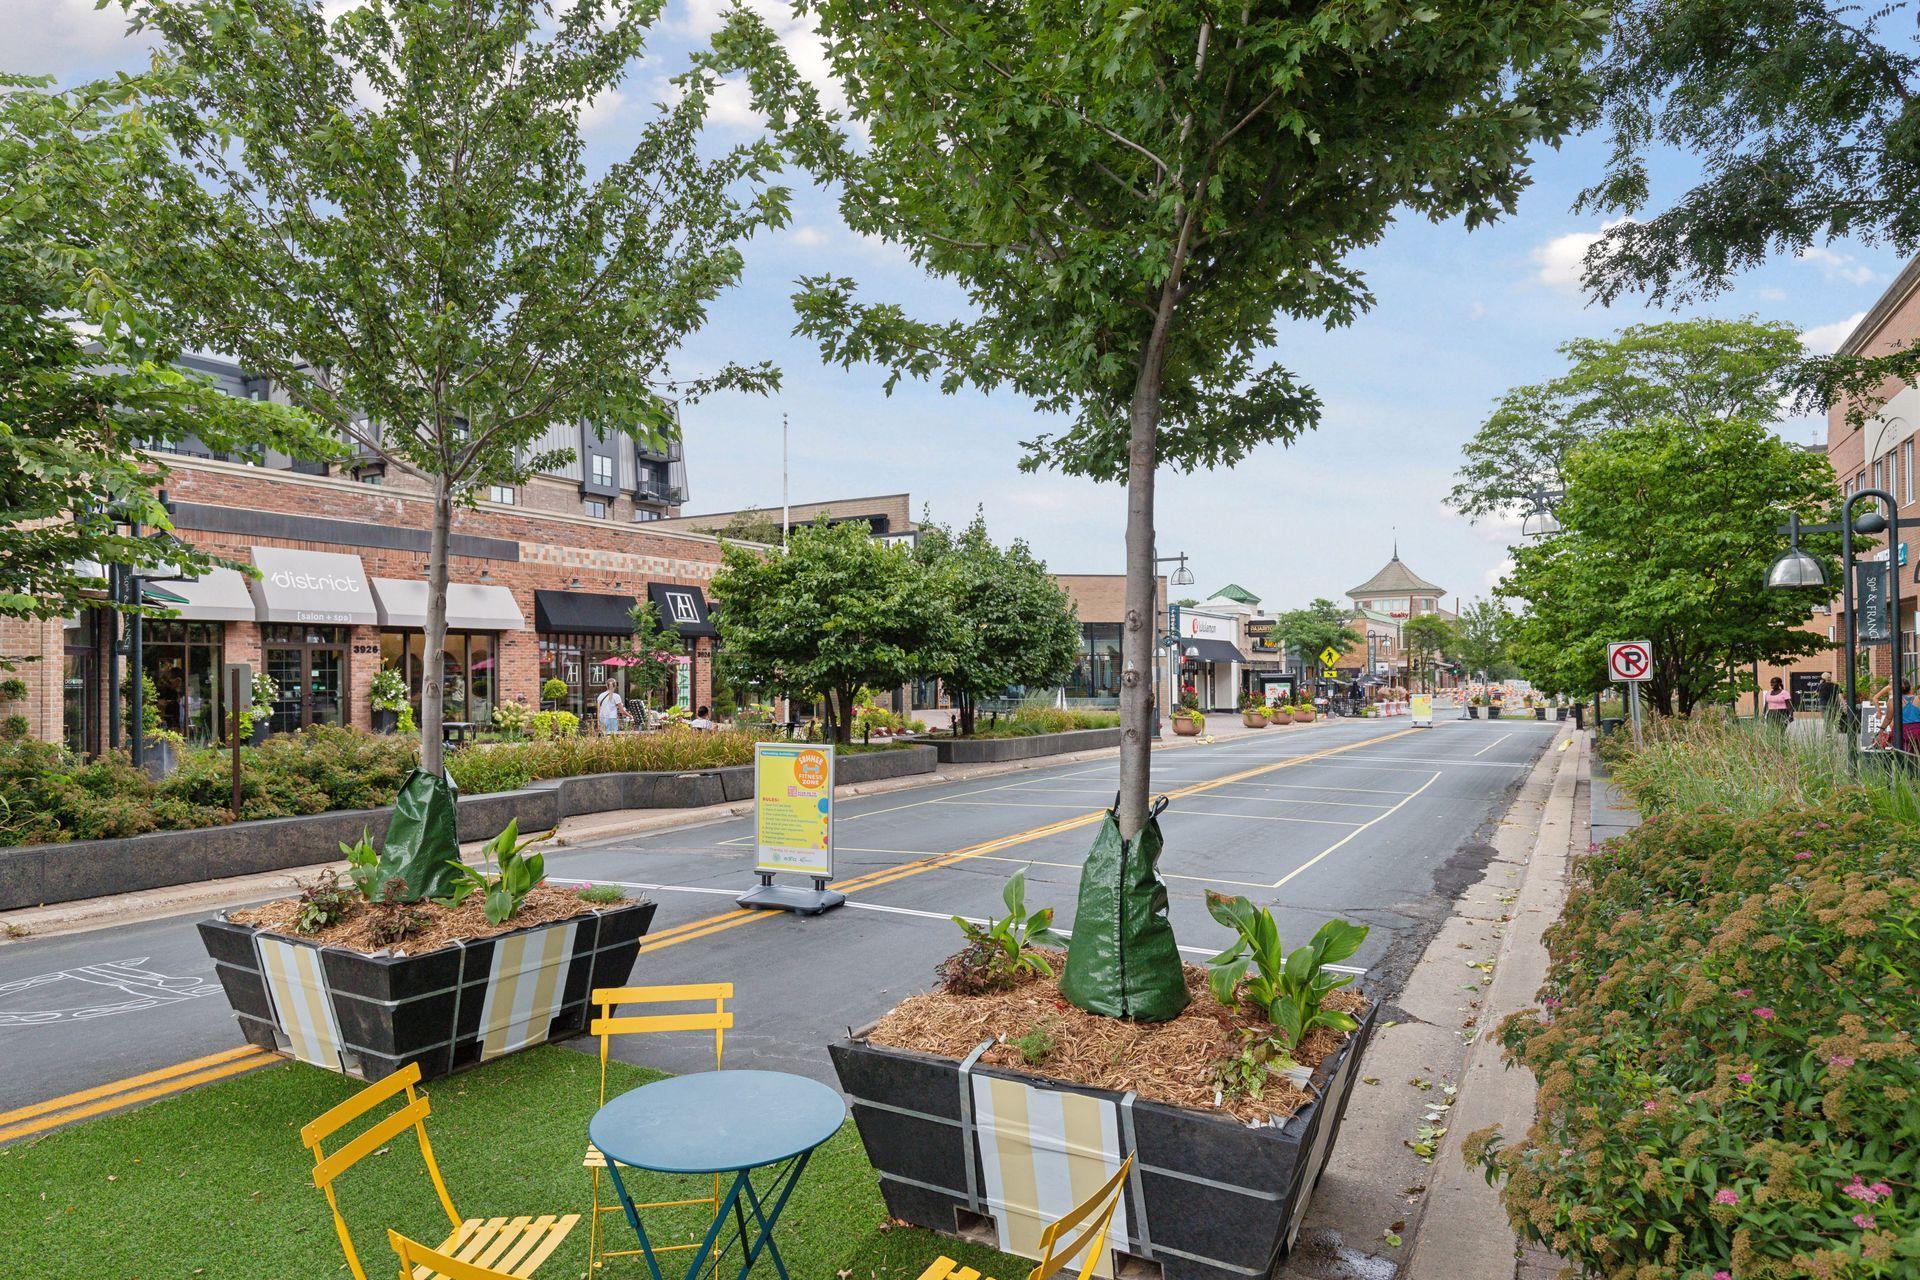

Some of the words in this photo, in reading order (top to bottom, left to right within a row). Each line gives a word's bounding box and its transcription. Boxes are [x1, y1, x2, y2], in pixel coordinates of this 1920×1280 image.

[353, 645, 378, 654] 3926
[678, 663, 690, 708] SALE
[798, 755, 824, 766] SUMMER
[798, 773, 824, 781] FITNESS
